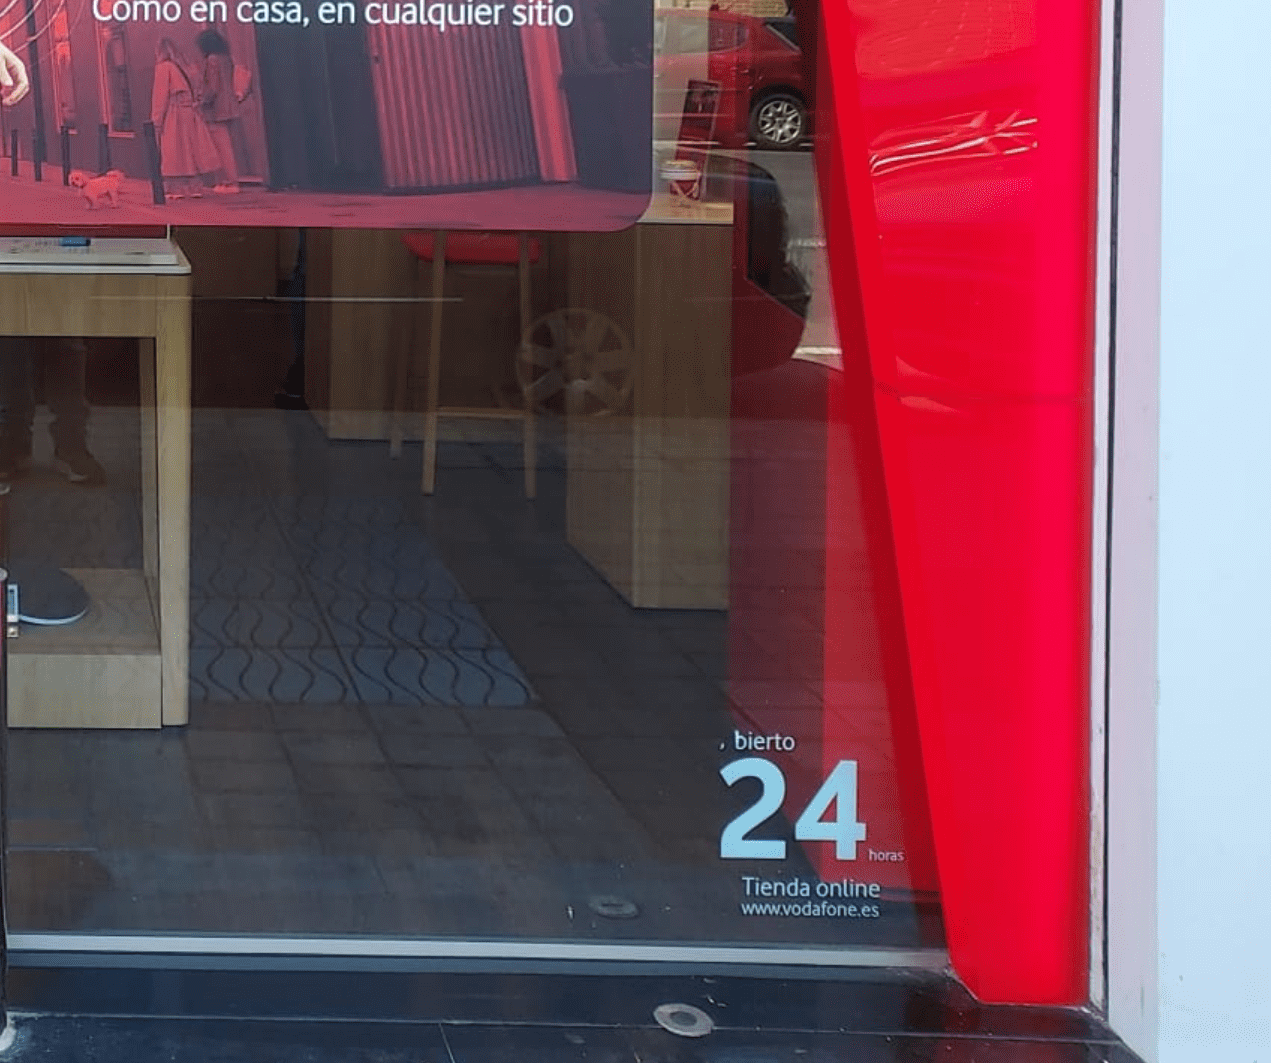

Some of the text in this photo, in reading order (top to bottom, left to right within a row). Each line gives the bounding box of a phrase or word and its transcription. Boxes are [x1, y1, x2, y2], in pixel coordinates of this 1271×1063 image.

[236, 0, 310, 28] casa,
[318, 2, 356, 25] en
[718, 729, 796, 751] bierto
[718, 757, 905, 862] 24 horas
[741, 876, 881, 898] Tienda online
[741, 900, 880, 918] www.vodafone.es
